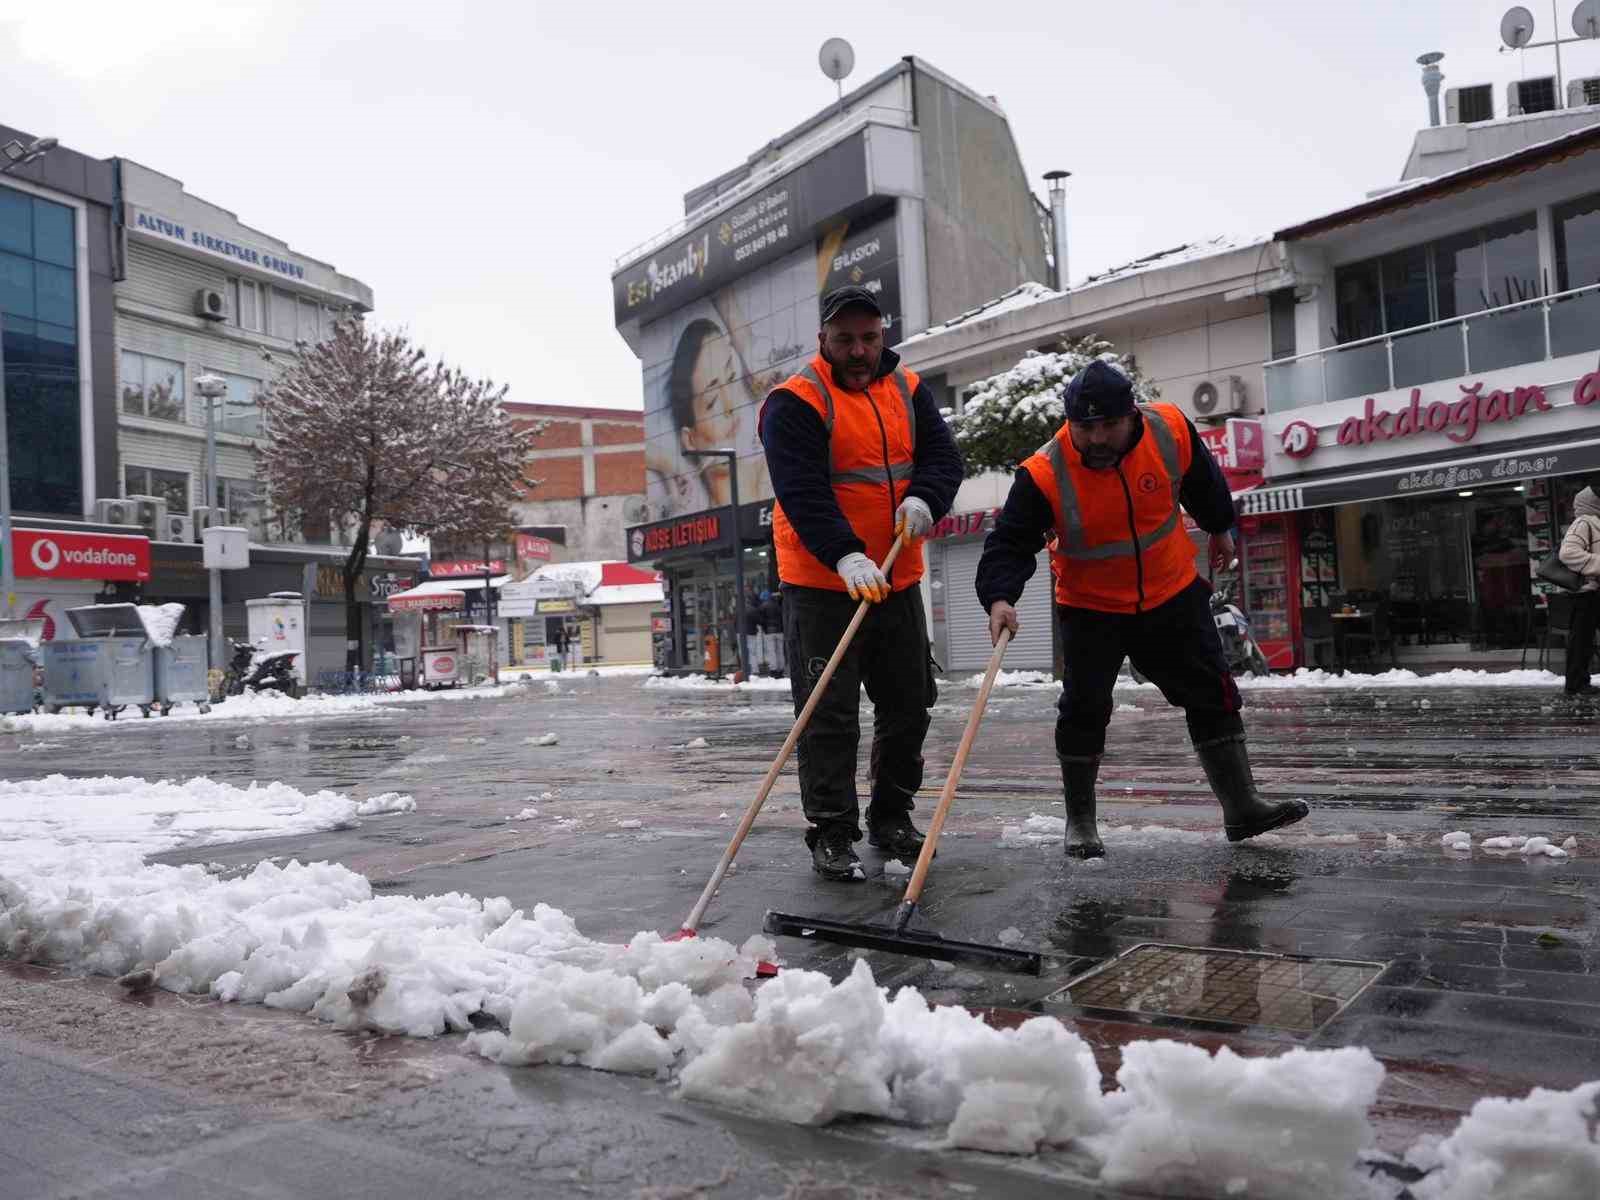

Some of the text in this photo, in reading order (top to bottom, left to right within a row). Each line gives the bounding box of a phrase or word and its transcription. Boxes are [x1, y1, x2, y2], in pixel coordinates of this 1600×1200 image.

[137, 212, 185, 241] ALTUN
[262, 254, 304, 280] GRUBU
[1337, 381, 1553, 445] akdoğan
[1398, 456, 1559, 489] akdoğan döner
[63, 547, 137, 566] vodafone
